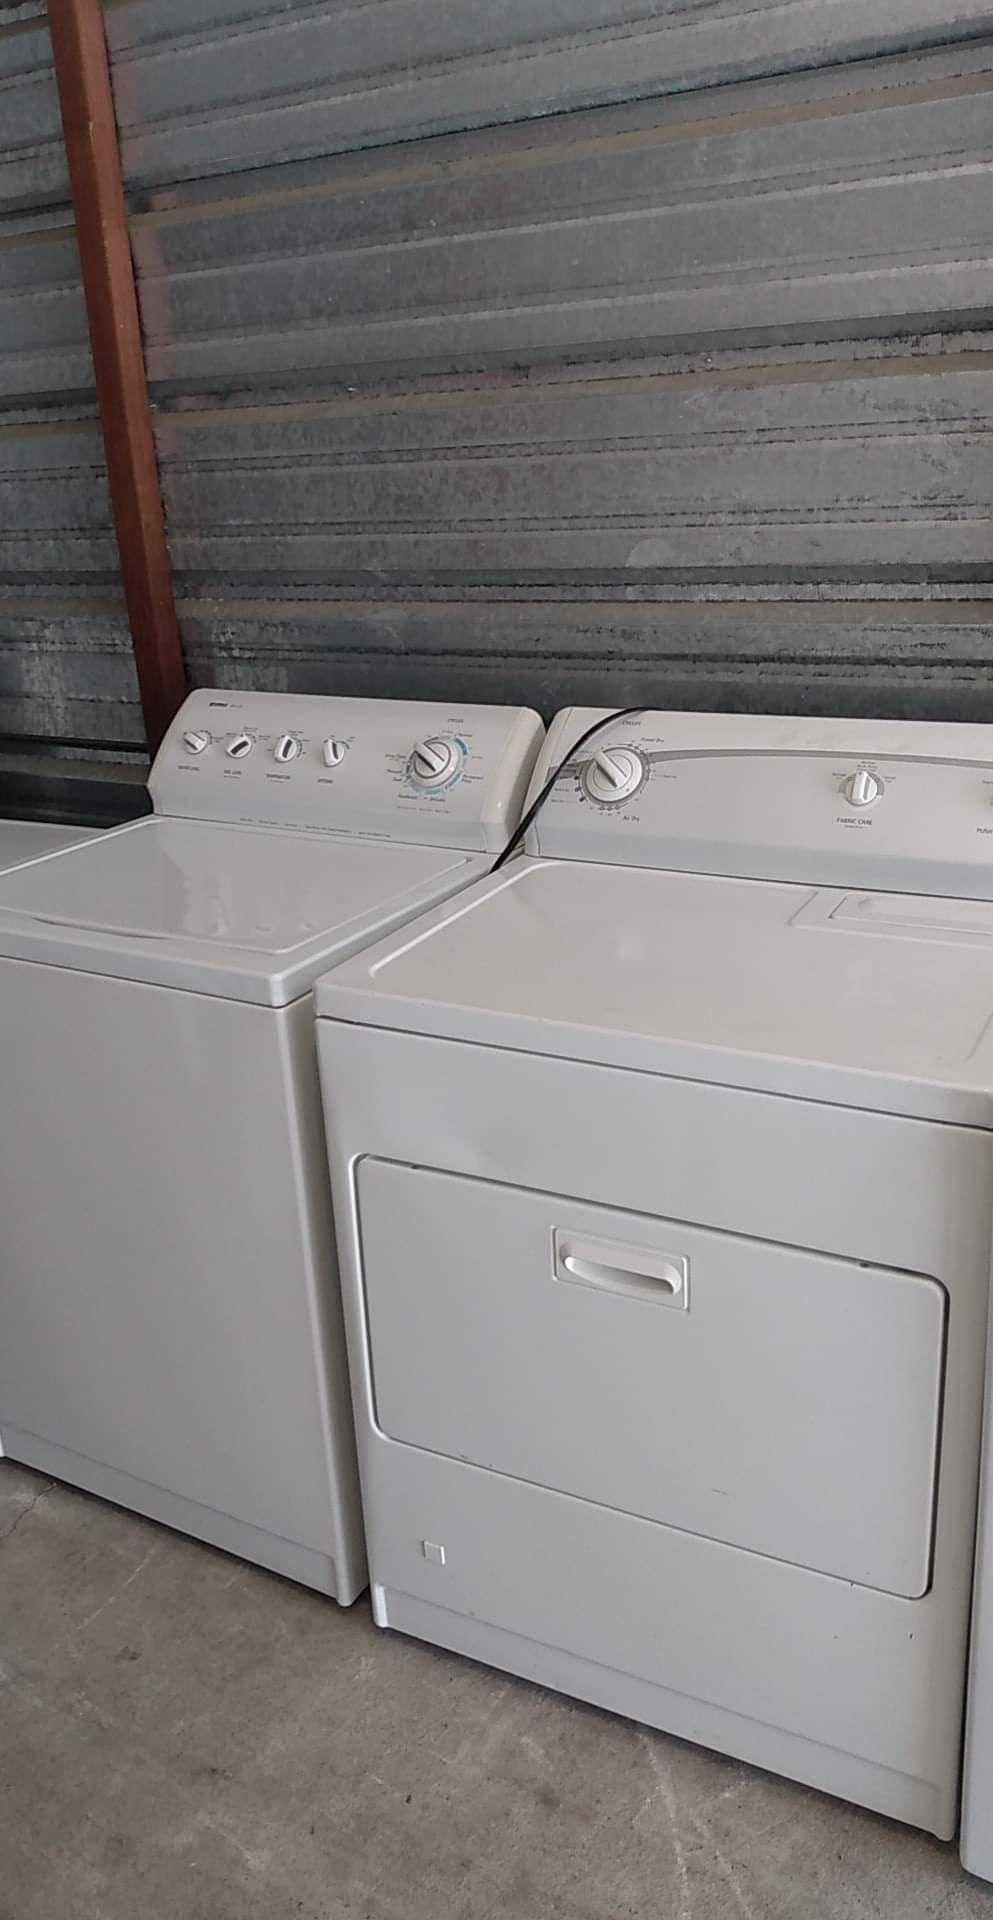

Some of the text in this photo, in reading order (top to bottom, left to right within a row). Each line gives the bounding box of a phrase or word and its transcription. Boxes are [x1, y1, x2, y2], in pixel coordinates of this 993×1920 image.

[836, 817, 873, 826] FABRIC CARE
[976, 827, 993, 835] PUSH
